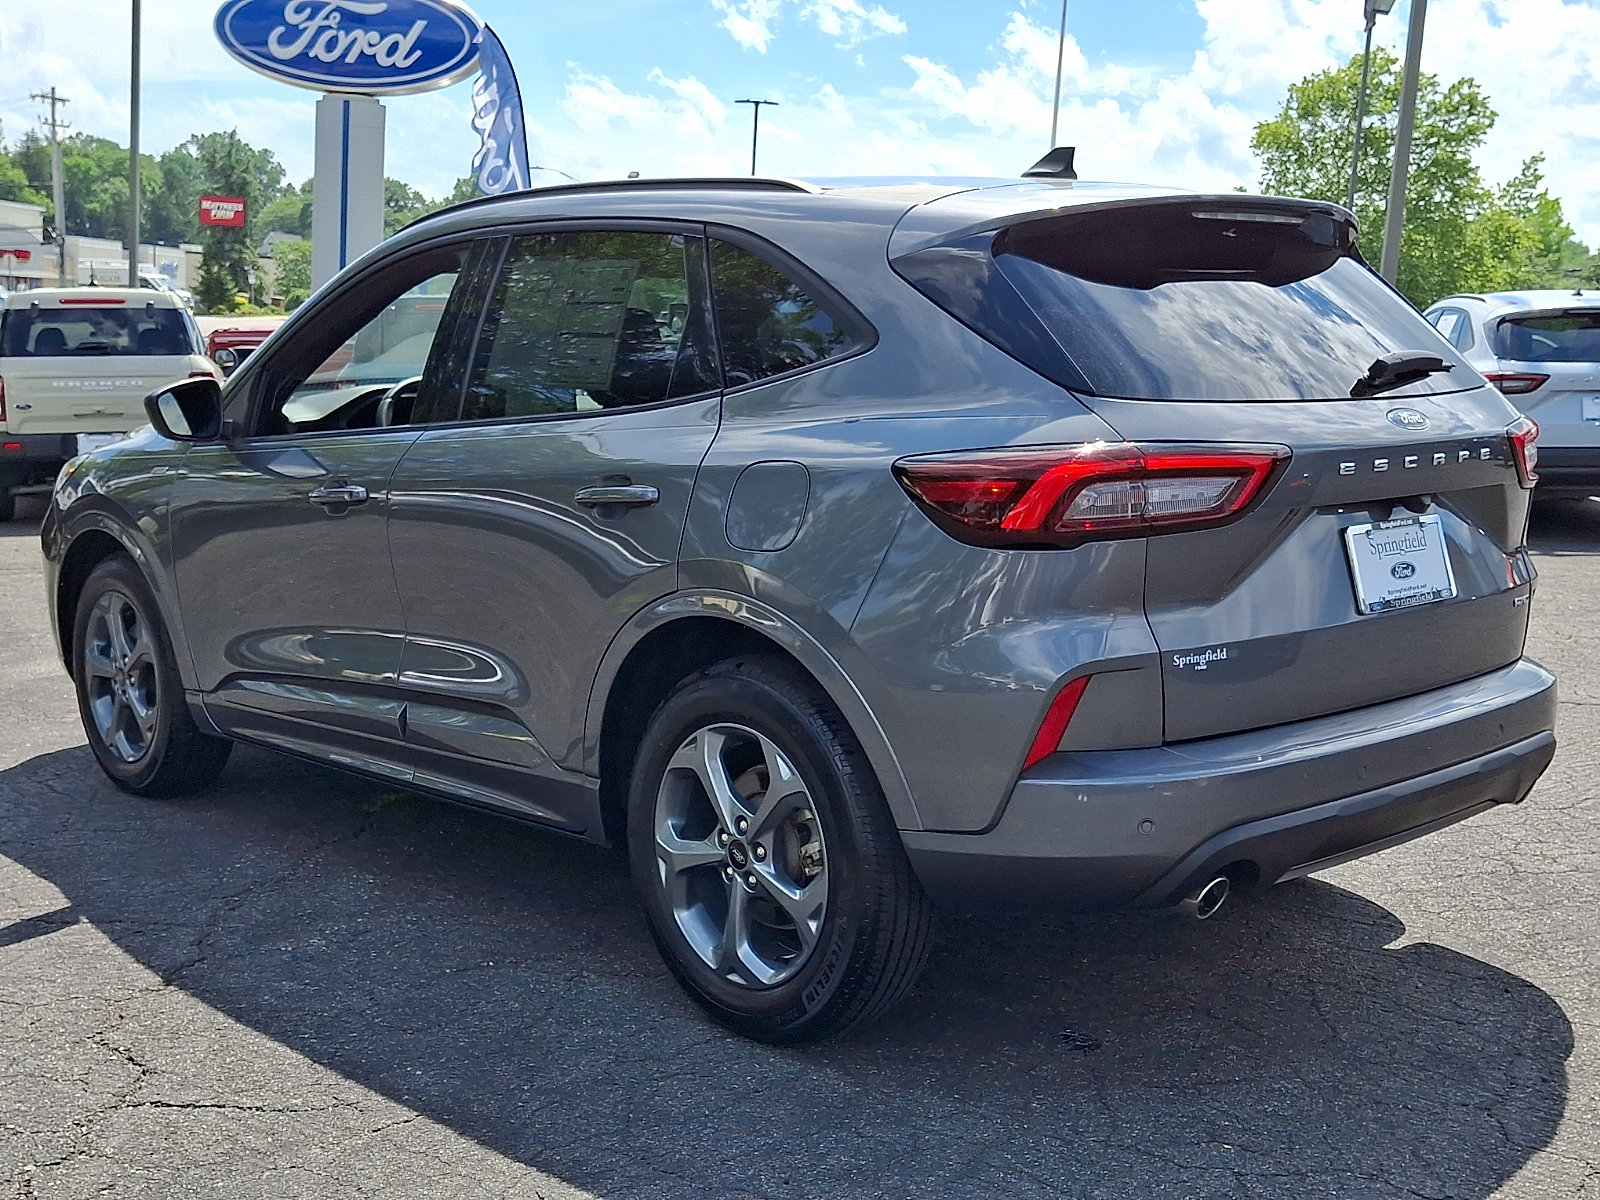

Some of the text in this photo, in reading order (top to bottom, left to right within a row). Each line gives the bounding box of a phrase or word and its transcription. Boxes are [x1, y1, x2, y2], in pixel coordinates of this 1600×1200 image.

[267, 0, 429, 68] Ford
[1339, 447, 1491, 475] ESCAPE
[1369, 530, 1427, 560] Springfield
[1394, 564, 1413, 578] Ford
[1389, 592, 1434, 608] Springfield
[1173, 648, 1227, 668] Springfield
